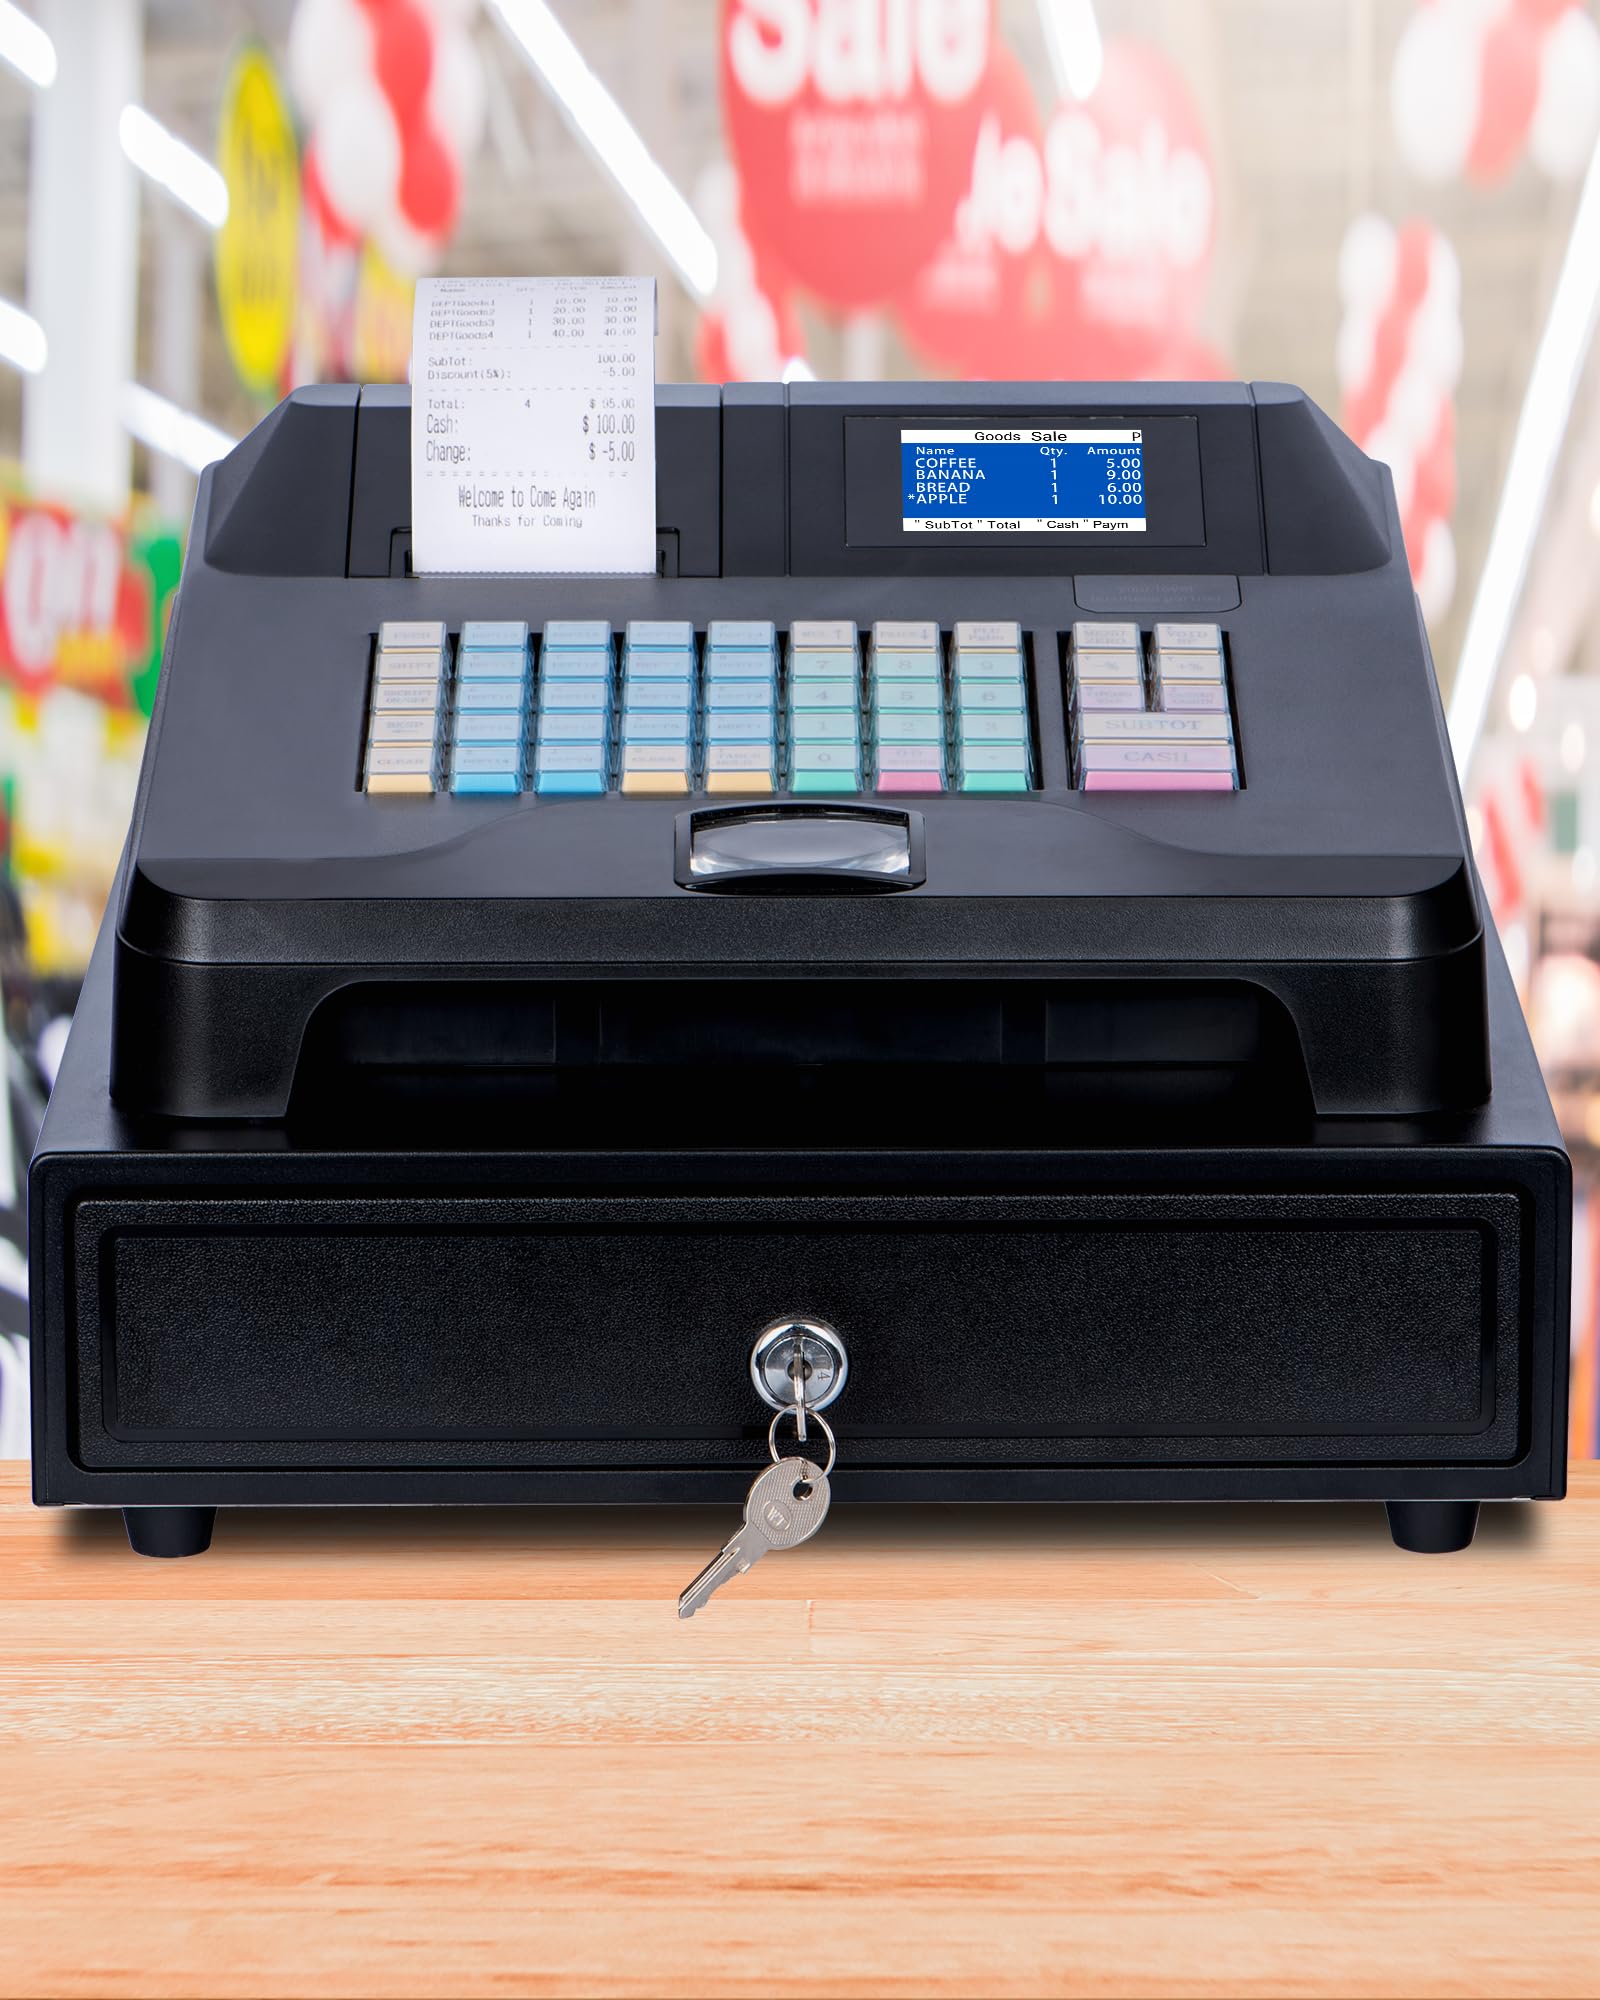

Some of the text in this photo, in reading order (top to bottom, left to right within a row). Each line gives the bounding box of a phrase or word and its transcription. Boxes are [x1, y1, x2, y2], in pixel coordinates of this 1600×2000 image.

[555, 297, 586, 305] 10.00
[607, 296, 638, 304] 10.00
[553, 306, 586, 314] 20.00
[604, 305, 637, 313] 20.00
[552, 317, 585, 325] 30.00
[604, 316, 637, 324] 30.00
[429, 331, 494, 341] DEPTGoods4
[552, 329, 585, 337] 40.00
[603, 328, 637, 337] 40.00
[428, 353, 636, 367] SubTot: 100.00
[428, 399, 465, 409] Total:
[524, 399, 531, 409] 4
[426, 413, 635, 435] Cash: $ 100.00
[974, 431, 1141, 442] Goods Sale P
[426, 440, 635, 464] Change: $ -5.00
[916, 447, 1141, 457] Name Qty. Amount
[915, 458, 1141, 468] COFFEE 1 5.00
[916, 470, 1141, 480] BANANA 1 9.00
[916, 482, 1142, 493] BREAD 1 6.00
[458, 485, 596, 511] Welcome to Come Again
[1052, 494, 1058, 505] 1
[1099, 494, 1142, 505] 10.00
[472, 514, 583, 528] Thanks for Coming
[925, 520, 1129, 531] SubTot Total Cash Paym
[1104, 718, 1202, 730] SUBTOT
